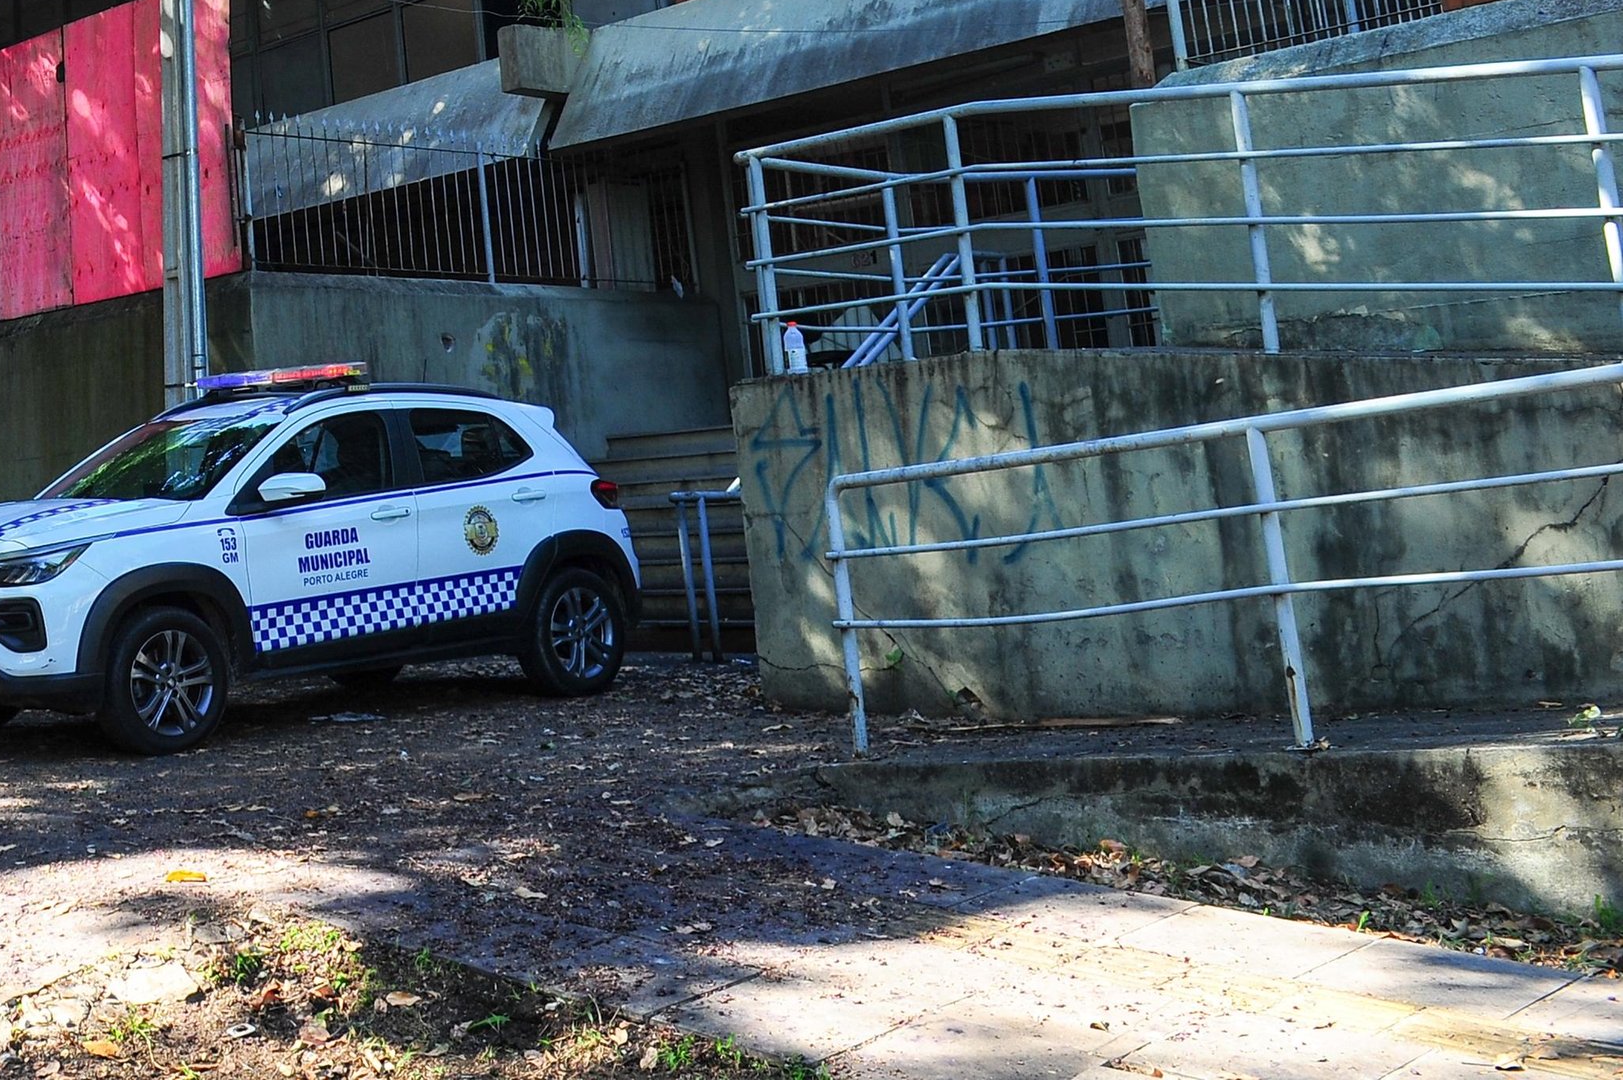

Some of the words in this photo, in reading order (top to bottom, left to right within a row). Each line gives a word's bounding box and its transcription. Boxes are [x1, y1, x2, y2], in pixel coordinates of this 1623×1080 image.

[220, 537, 237, 552] 153
[305, 527, 359, 550] GUARDA
[222, 552, 239, 564] GM
[298, 547, 371, 574] MUNICIPAL
[303, 573, 333, 587] PORTO
[334, 568, 369, 583] ALEGRE
